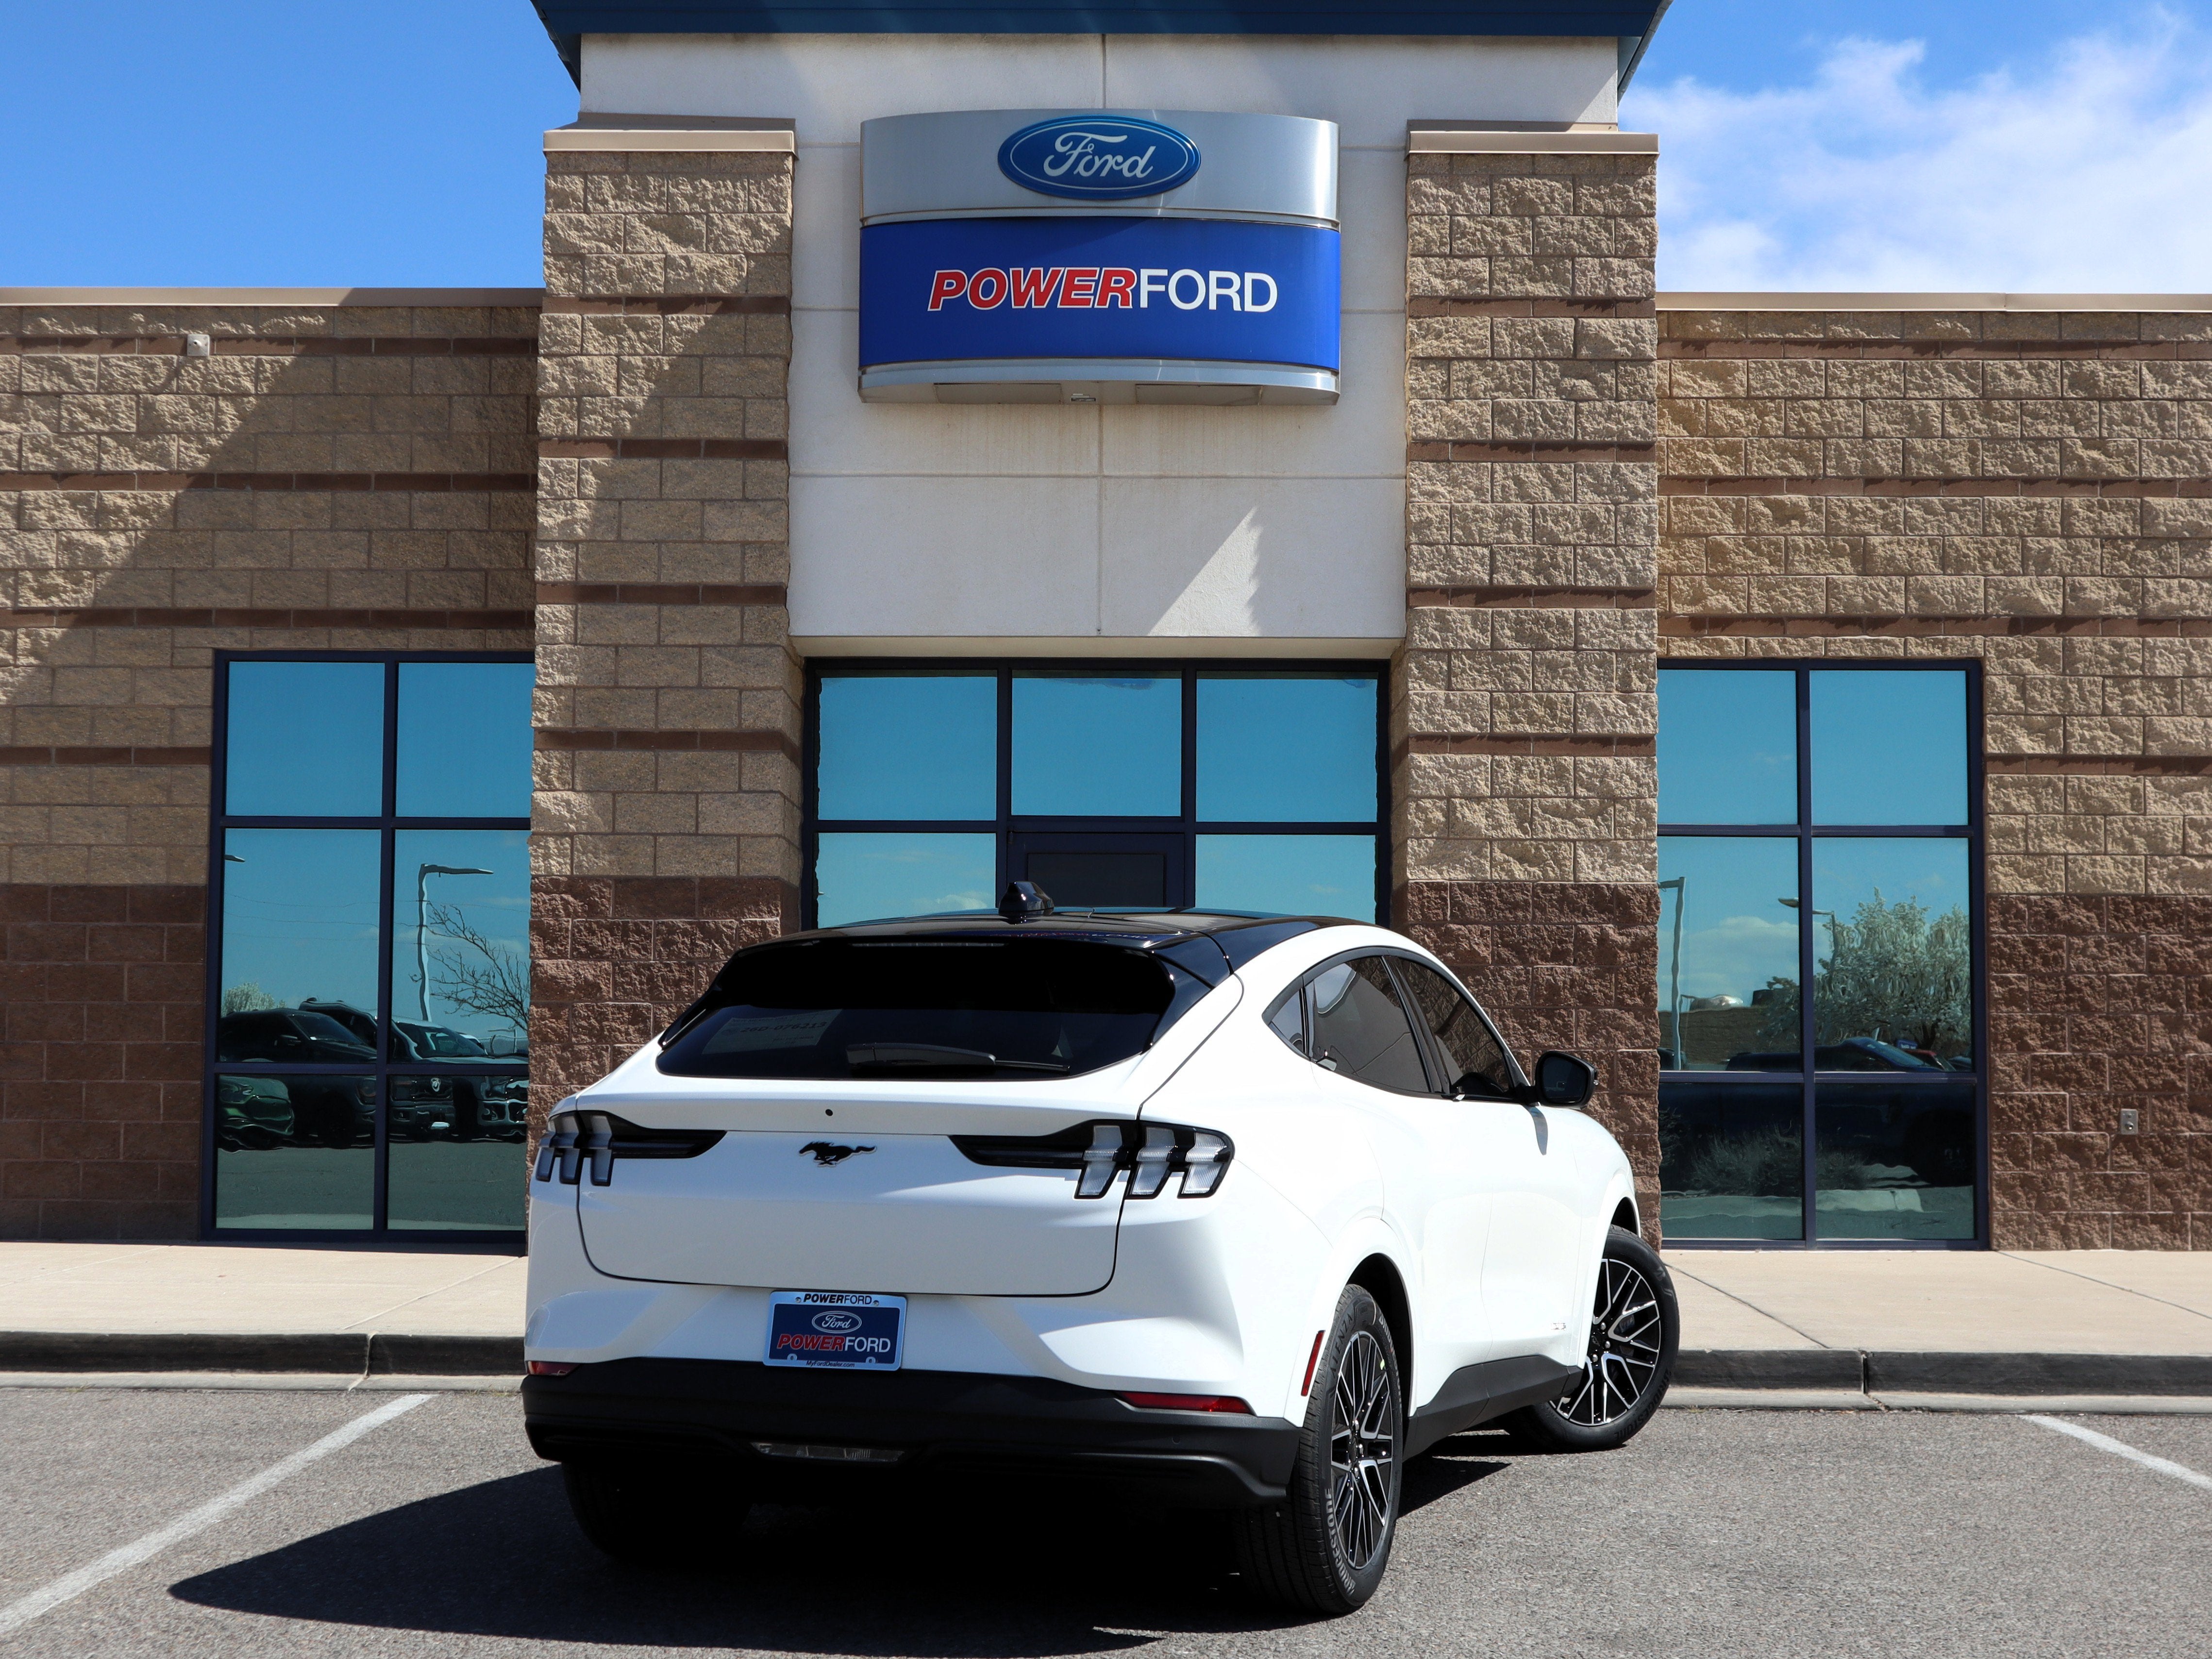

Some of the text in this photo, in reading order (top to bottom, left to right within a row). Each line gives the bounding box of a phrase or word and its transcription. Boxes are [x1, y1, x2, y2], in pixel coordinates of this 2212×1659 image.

[1043, 132, 1157, 179] Ford
[927, 267, 1278, 313] POWERFORD
[803, 1293, 872, 1305] POWERFORD
[821, 1315, 852, 1328] Ford
[777, 1334, 891, 1353] POWERFORD
[1324, 1488, 1357, 1597] BRIDGESTONE
